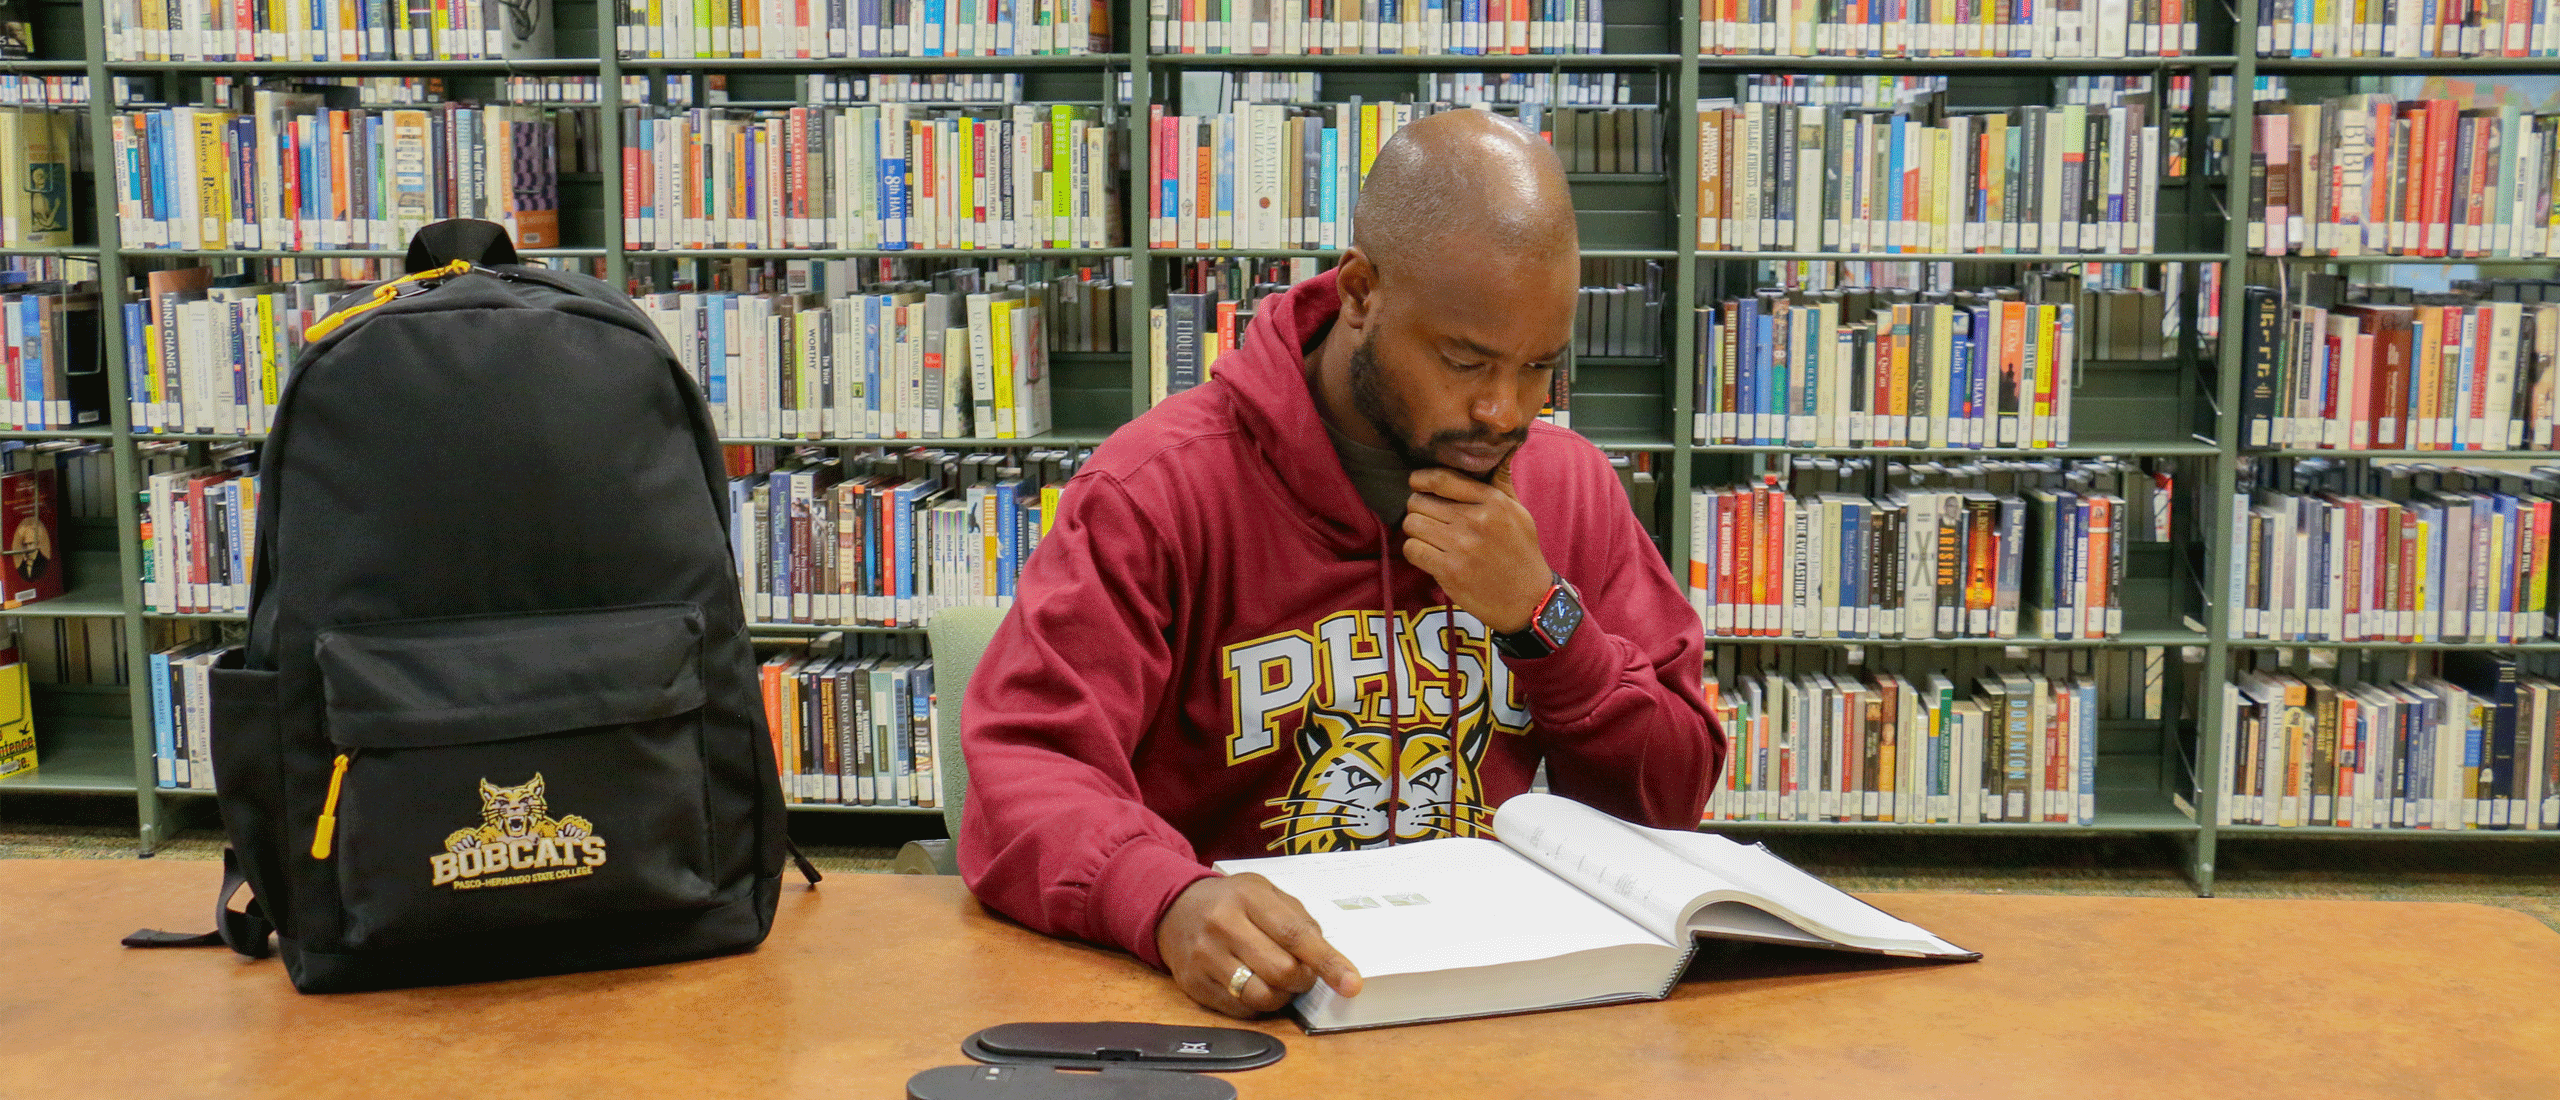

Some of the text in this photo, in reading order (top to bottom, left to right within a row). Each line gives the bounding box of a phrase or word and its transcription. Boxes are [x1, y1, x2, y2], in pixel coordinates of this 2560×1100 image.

[199, 122, 213, 163] History
[1020, 135, 1028, 154] GRIT
[1253, 109, 1265, 195] CIVILIZATION
[1701, 121, 1711, 183] MYTHOLOGY
[1747, 119, 1760, 188] VILLAGE ATHEISTS
[2129, 135, 2140, 158] HOLY
[459, 149, 470, 184] BRAIN
[795, 143, 803, 191] LANGUAGE
[1265, 126, 1277, 195] EMPATHIC
[1767, 155, 1775, 174] GOD
[2128, 159, 2138, 177] WAR
[625, 163, 638, 219] deception
[673, 164, 681, 206] HELPING
[884, 176, 900, 195] 8th
[161, 299, 176, 375] MIND CHANGE
[1226, 312, 1235, 328] How
[807, 328, 818, 370] WORTHY
[973, 311, 988, 391] UNGIFTED
[1176, 320, 1194, 376] ETIQUETTE
[1953, 340, 1965, 374] Hadith
[822, 367, 832, 385] Voice
[1973, 378, 1985, 408] ISLAM
[232, 529, 241, 552] LIGHT
[826, 521, 837, 569] Co-Sleeping
[934, 534, 942, 562] mindset
[945, 534, 954, 562] mindset
[957, 534, 965, 562] mindset
[1794, 519, 1808, 596] THE EVERLASTING
[1936, 527, 1956, 586] ARISING
[2478, 544, 2488, 563] WAR
[1737, 546, 1749, 584] ISLAM
[839, 676, 852, 690] THE
[840, 693, 852, 712] END
[913, 697, 930, 722] BIG
[2008, 700, 2029, 779] DOMINION
[2081, 756, 2094, 785] faith
[430, 835, 607, 886] BOBCATS
[453, 865, 594, 891] PASCO-HERNANDO STATE COLLEGE
